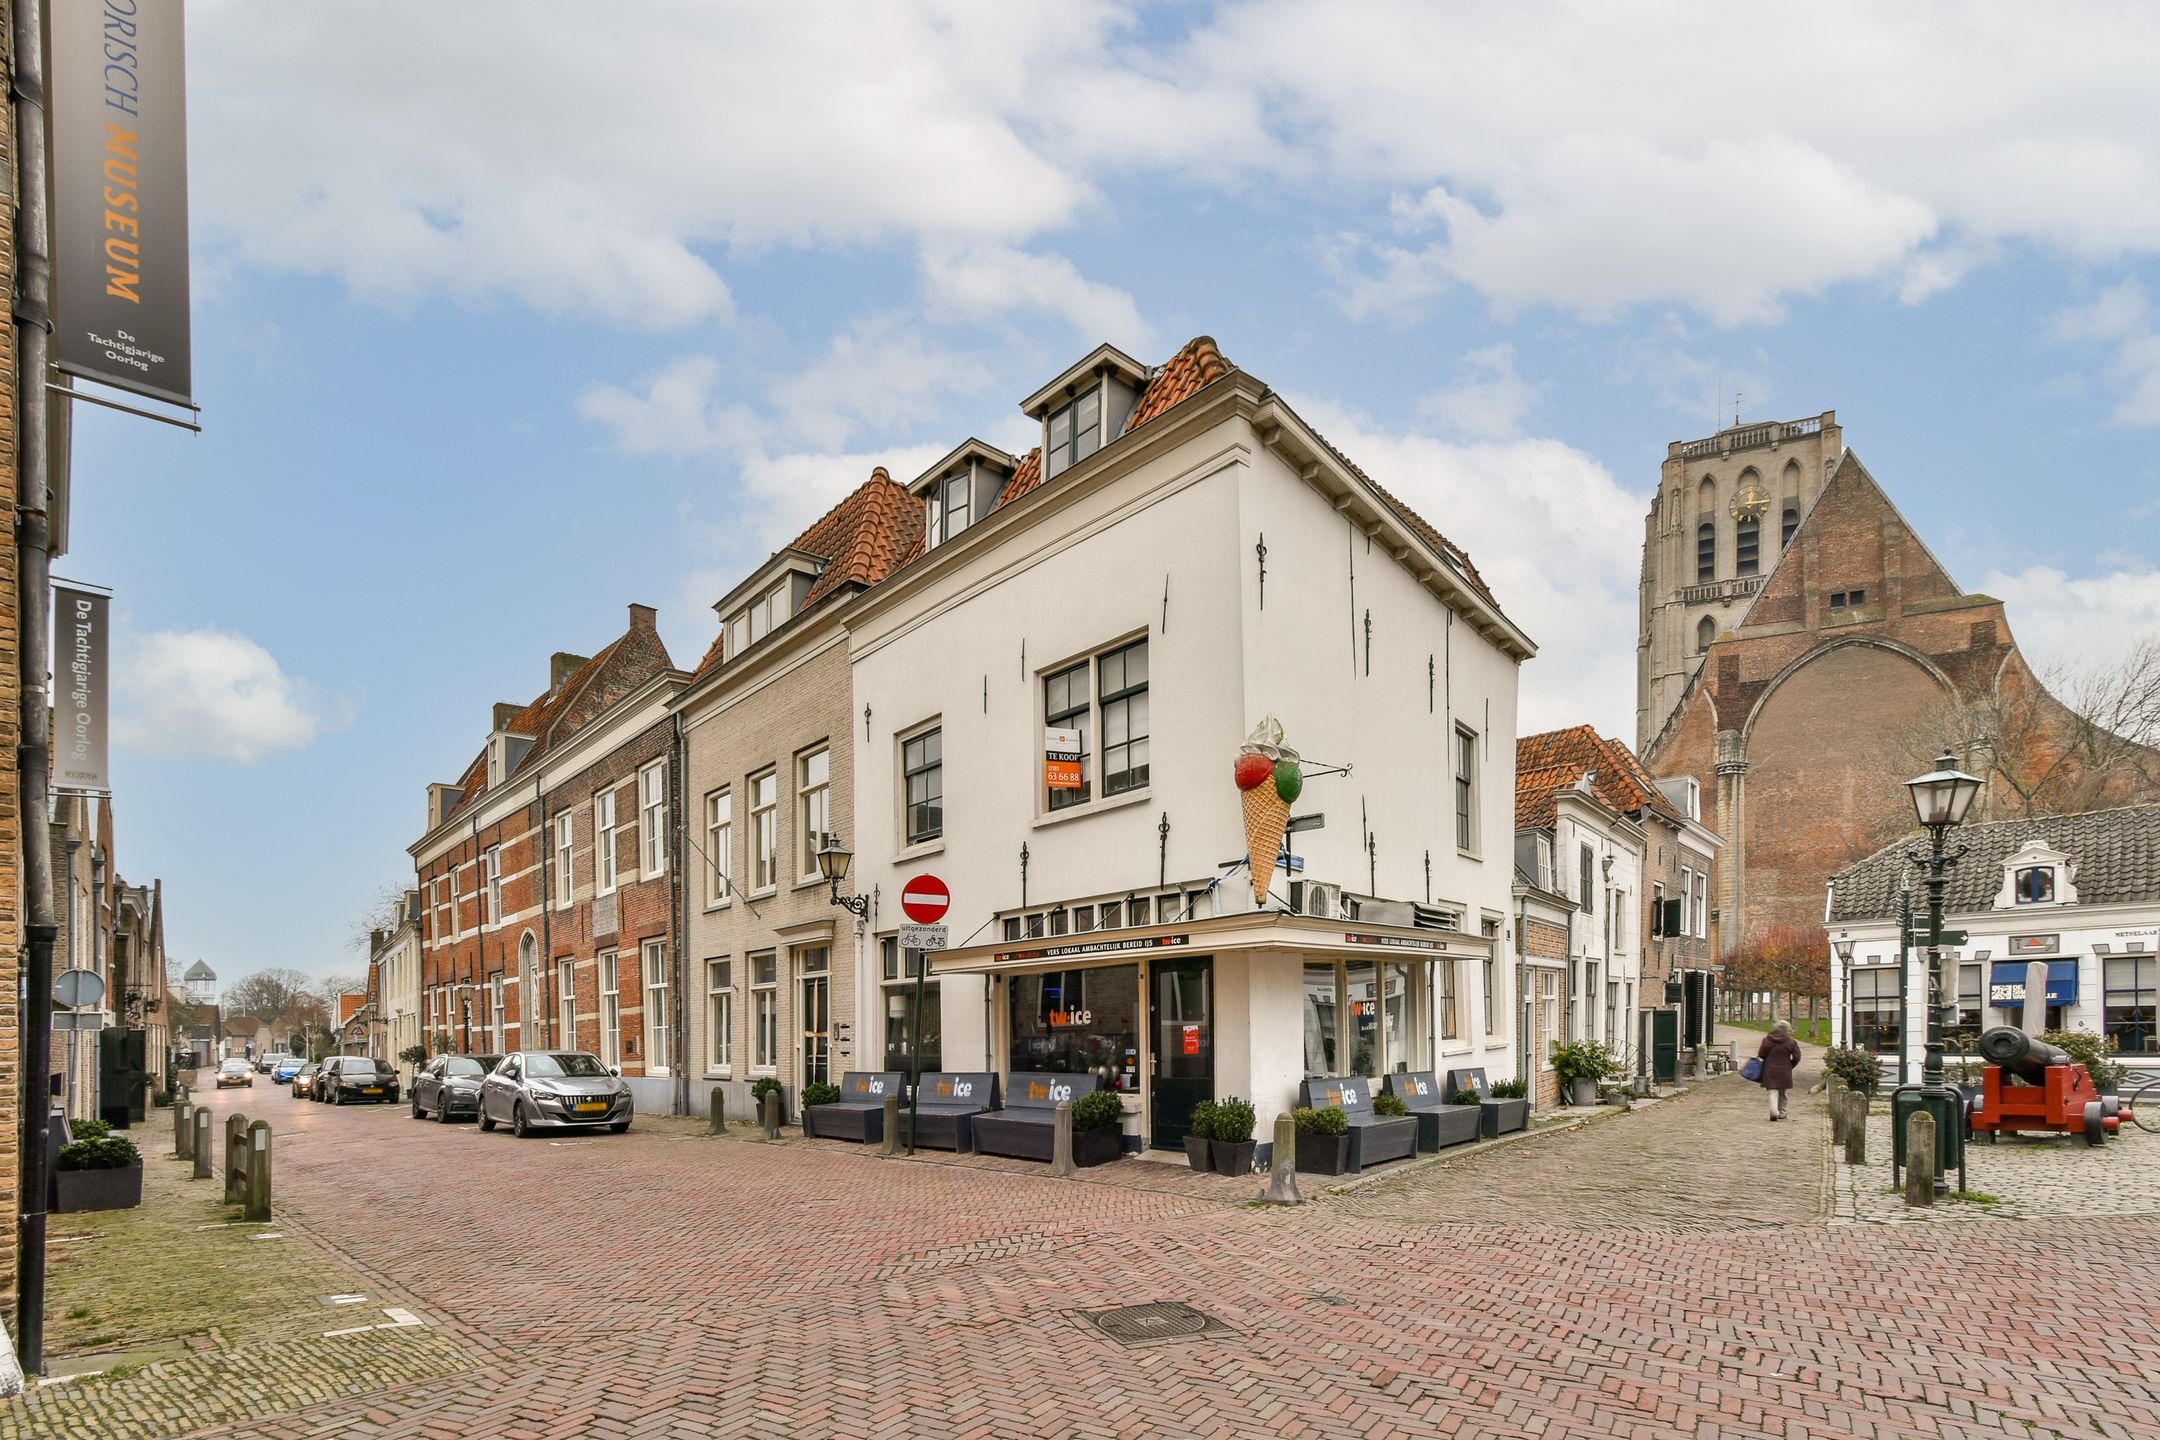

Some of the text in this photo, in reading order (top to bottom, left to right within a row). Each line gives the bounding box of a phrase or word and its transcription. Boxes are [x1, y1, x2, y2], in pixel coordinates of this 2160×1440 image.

[103, 122, 141, 304] MUSEUM
[117, 330, 135, 342] De
[87, 332, 165, 363] Tachtigjarige
[105, 350, 148, 371] Oorlog
[76, 600, 92, 619] De
[72, 623, 92, 708] Tachtigjarige
[72, 712, 91, 761] Oorlog
[1048, 752, 1079, 761] TE KOOP
[1048, 772, 1057, 780] 63
[1059, 772, 1068, 781] 66
[901, 925, 946, 933] uitgezonderd
[1047, 948, 1060, 956] VERS
[1061, 946, 1080, 955] LOKAAL
[1082, 942, 1121, 953] AMBACHTELIJK
[1122, 940, 1143, 949] BEREID
[1144, 939, 1153, 948] IJS
